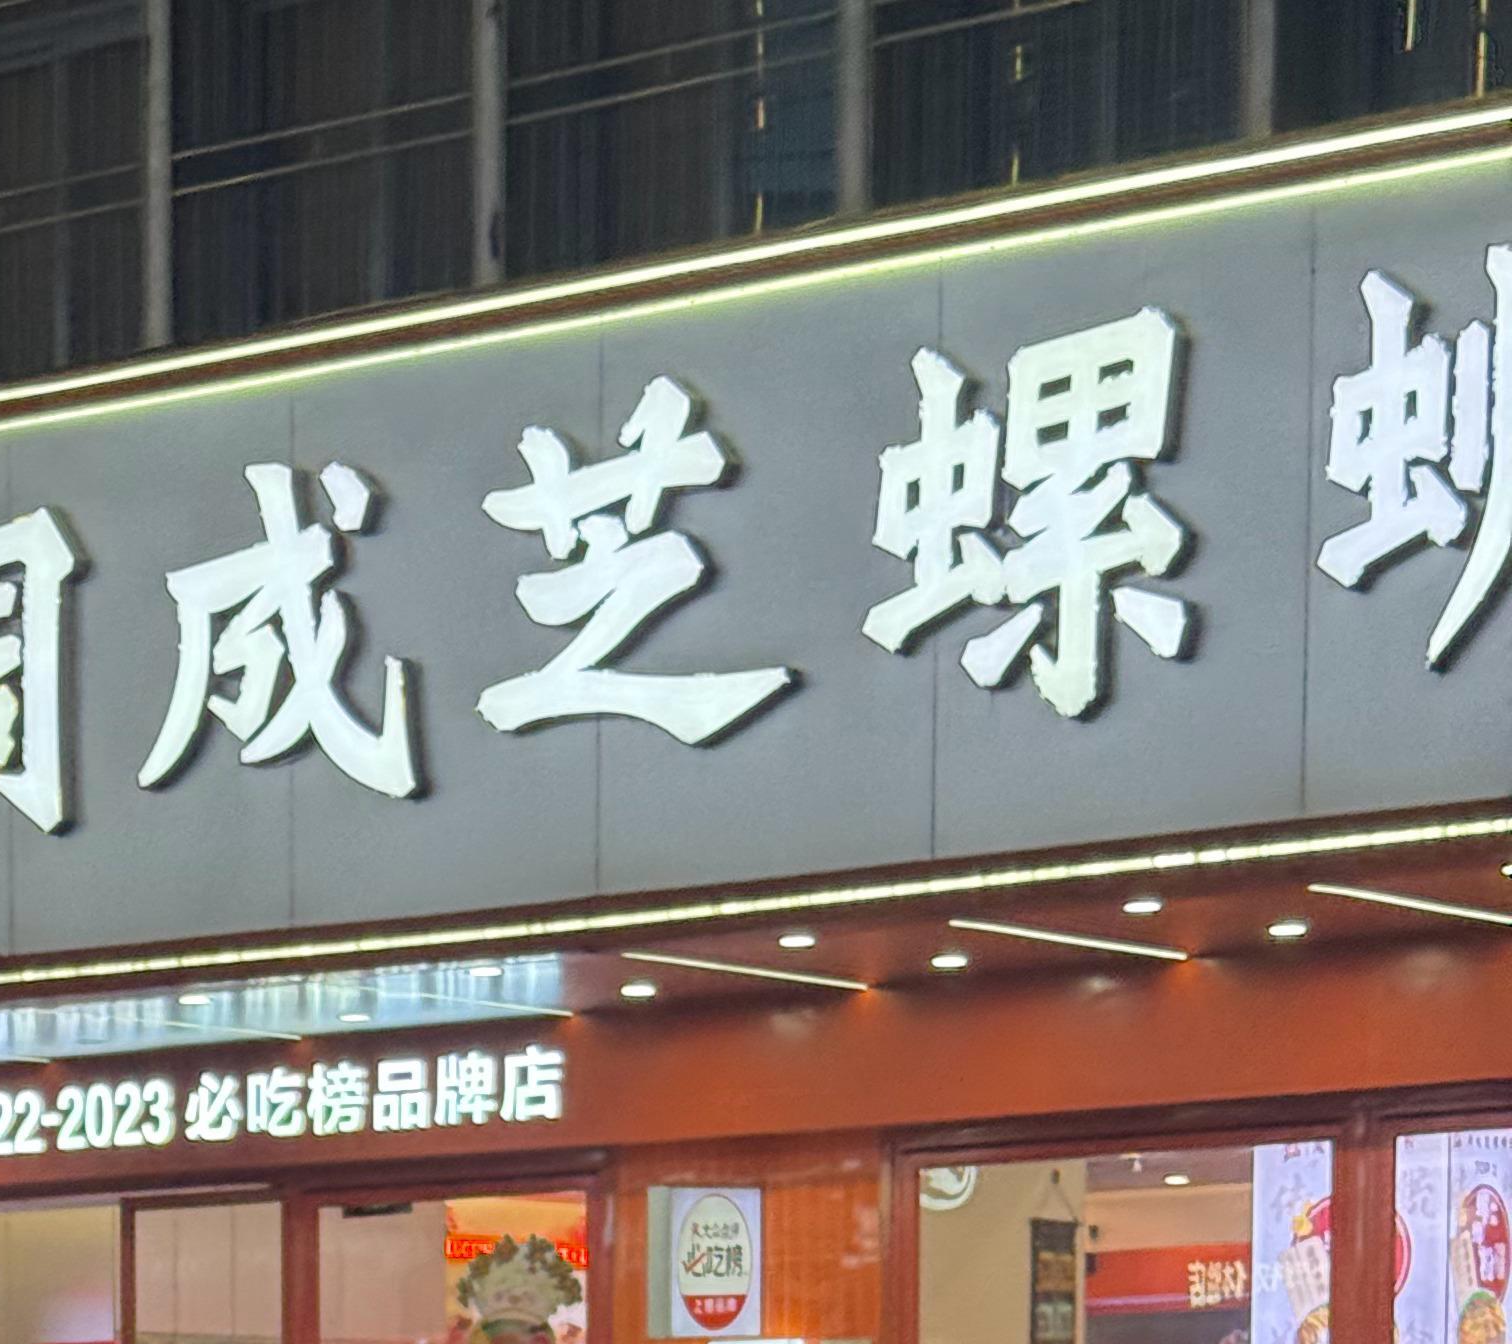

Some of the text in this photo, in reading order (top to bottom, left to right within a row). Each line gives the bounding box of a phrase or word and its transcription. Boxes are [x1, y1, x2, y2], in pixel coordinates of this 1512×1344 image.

[185, 1045, 565, 1143] 必吃榜品牌店
